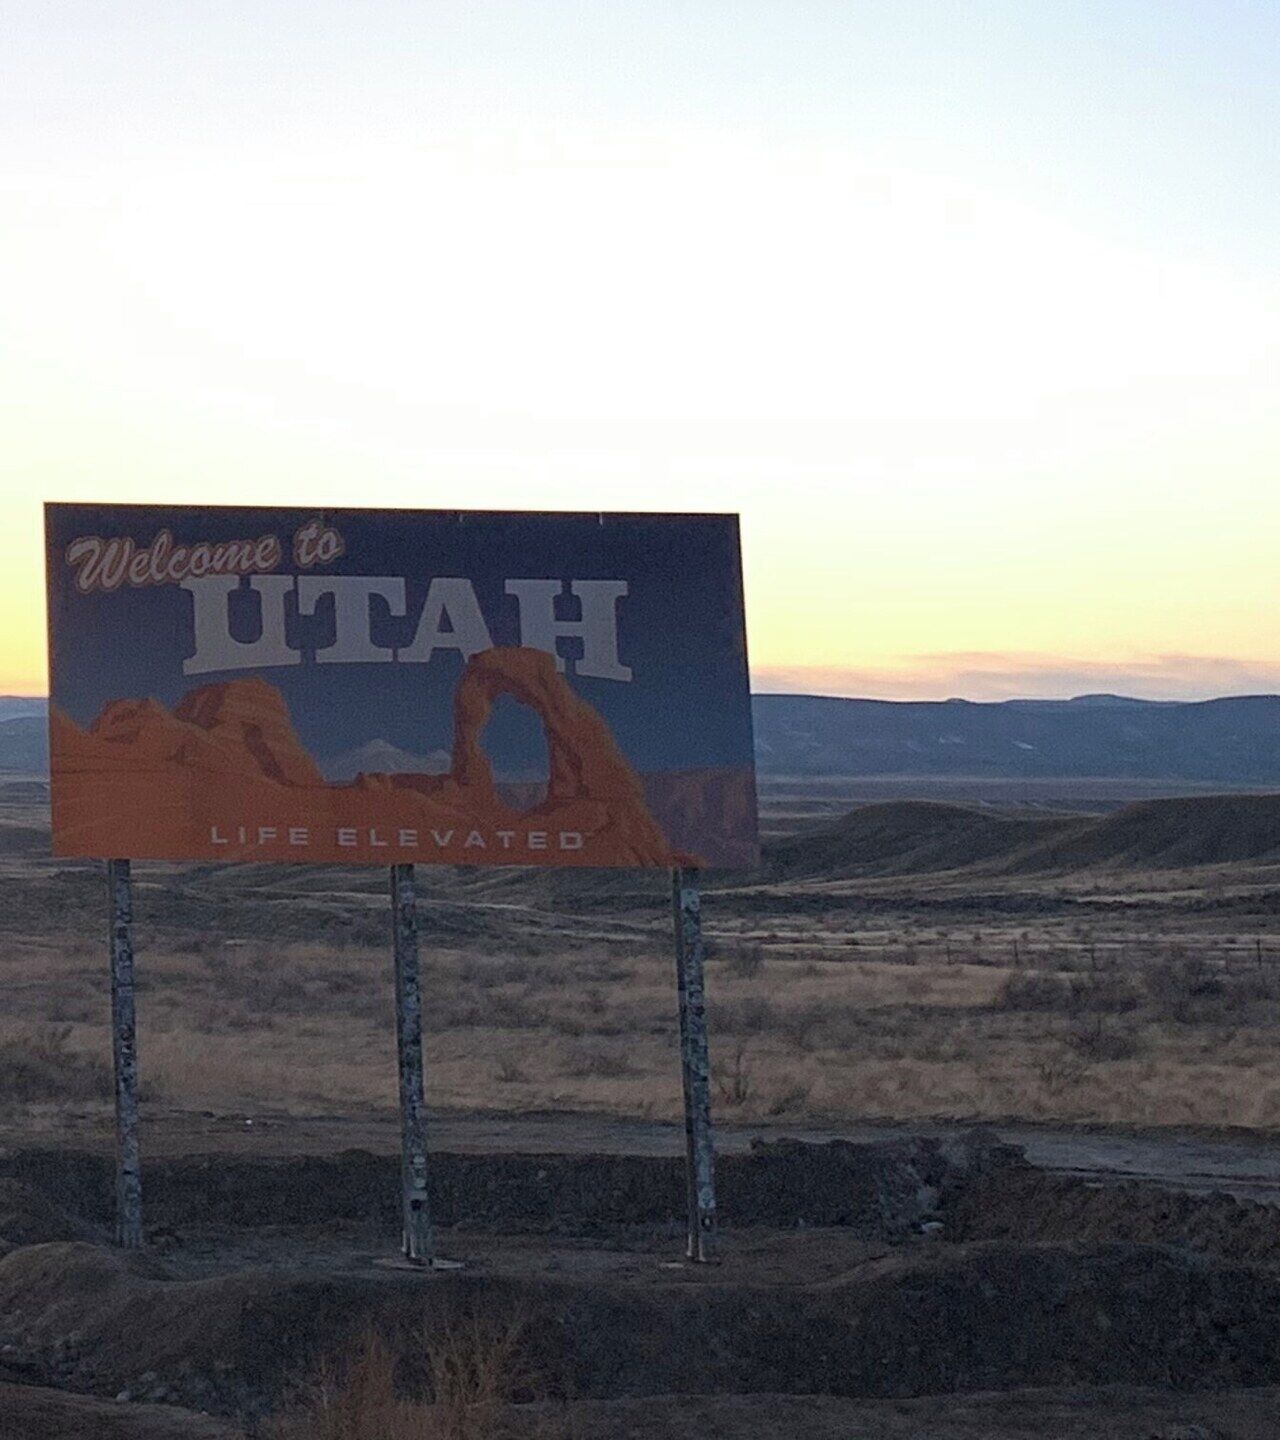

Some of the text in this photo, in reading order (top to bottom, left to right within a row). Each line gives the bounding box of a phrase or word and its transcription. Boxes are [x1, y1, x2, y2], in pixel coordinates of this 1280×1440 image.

[68, 523, 342, 591] Welcome to
[180, 574, 633, 682] UTAH
[211, 826, 585, 850] LIFE ELEVATED
